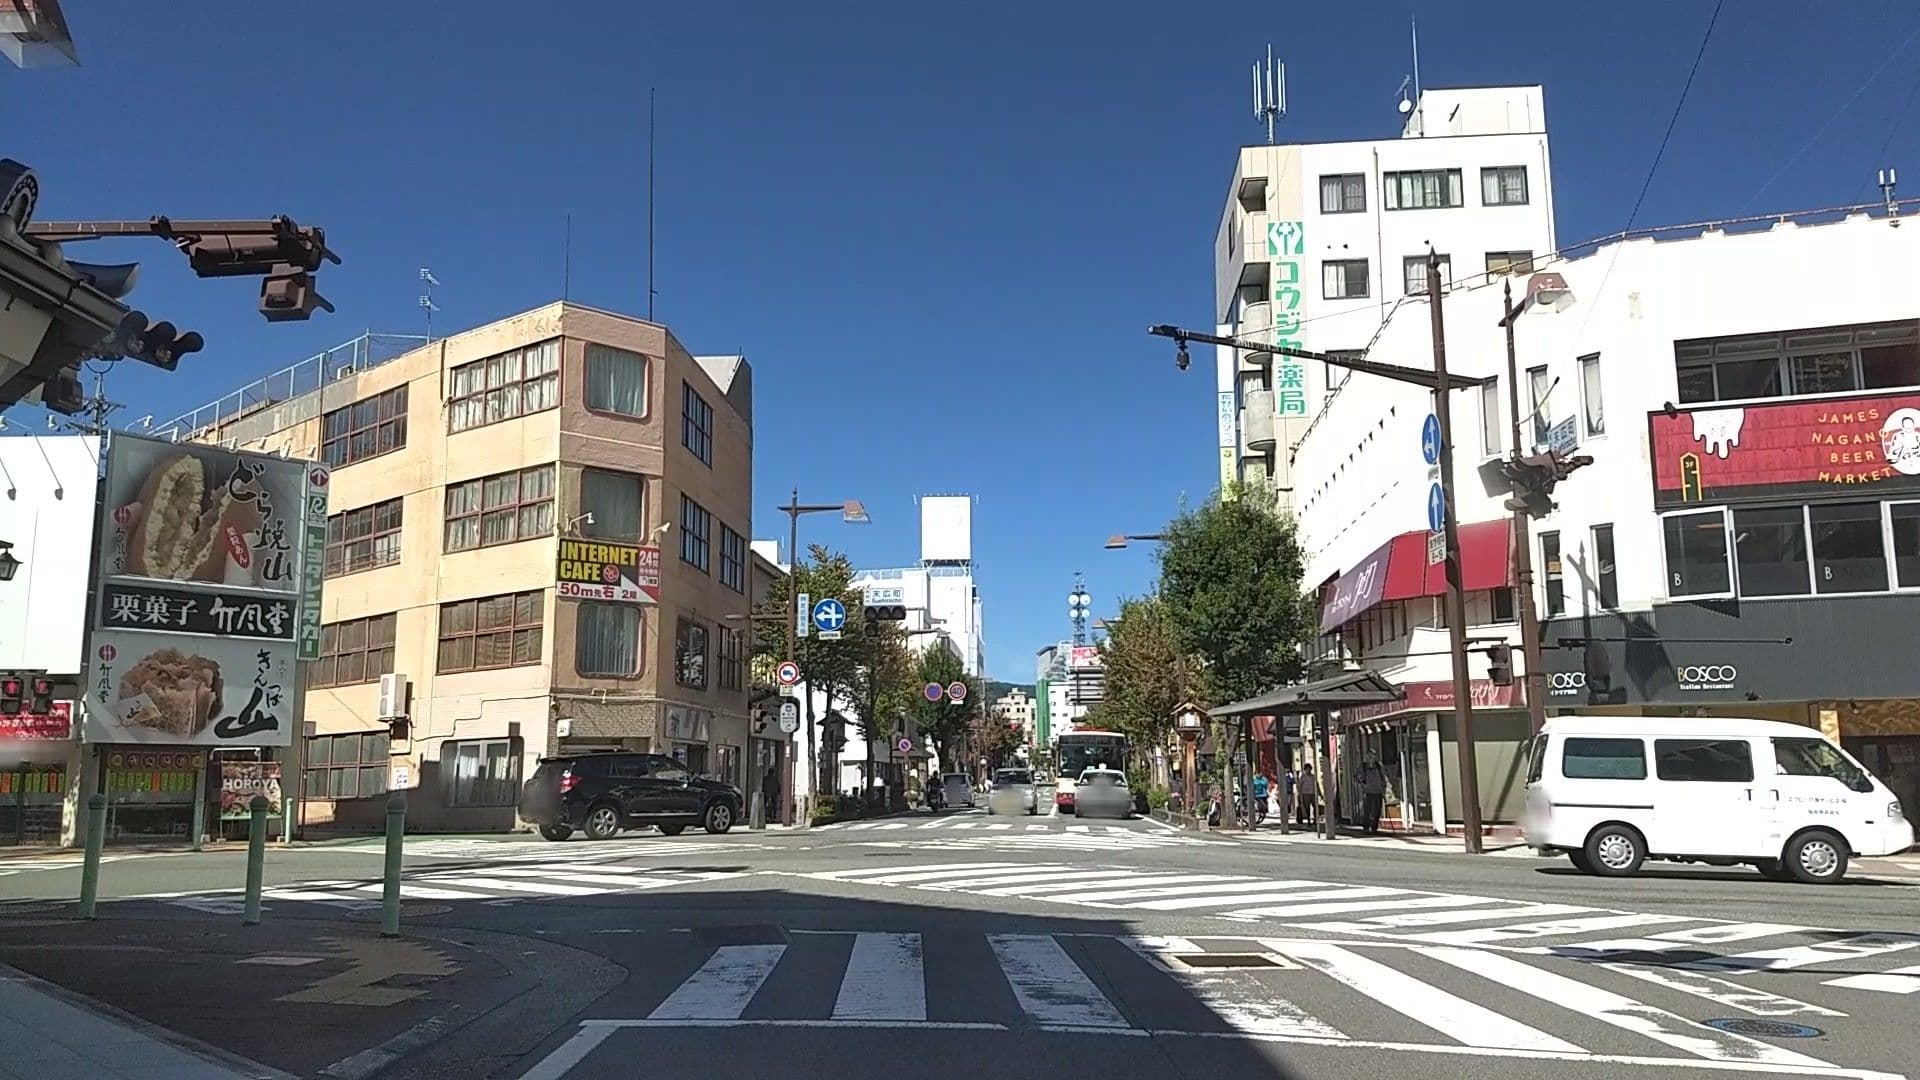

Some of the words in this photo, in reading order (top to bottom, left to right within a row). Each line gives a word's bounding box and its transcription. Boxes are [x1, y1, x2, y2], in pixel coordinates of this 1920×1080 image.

[1818, 408, 1879, 424] JAMES
[1811, 429, 1889, 445] NAGANO
[1830, 450, 1875, 463] BEER
[1818, 467, 1892, 484] MARKET
[560, 540, 638, 566] INTERNET
[560, 560, 601, 582] CAFE
[109, 593, 199, 627] 栗菓子
[209, 596, 290, 635] 竹風堂
[1546, 671, 1586, 689] BOSC
[1677, 665, 1737, 682] BOSCO
[951, 687, 962, 696] 40
[222, 777, 280, 791] HOROYA
